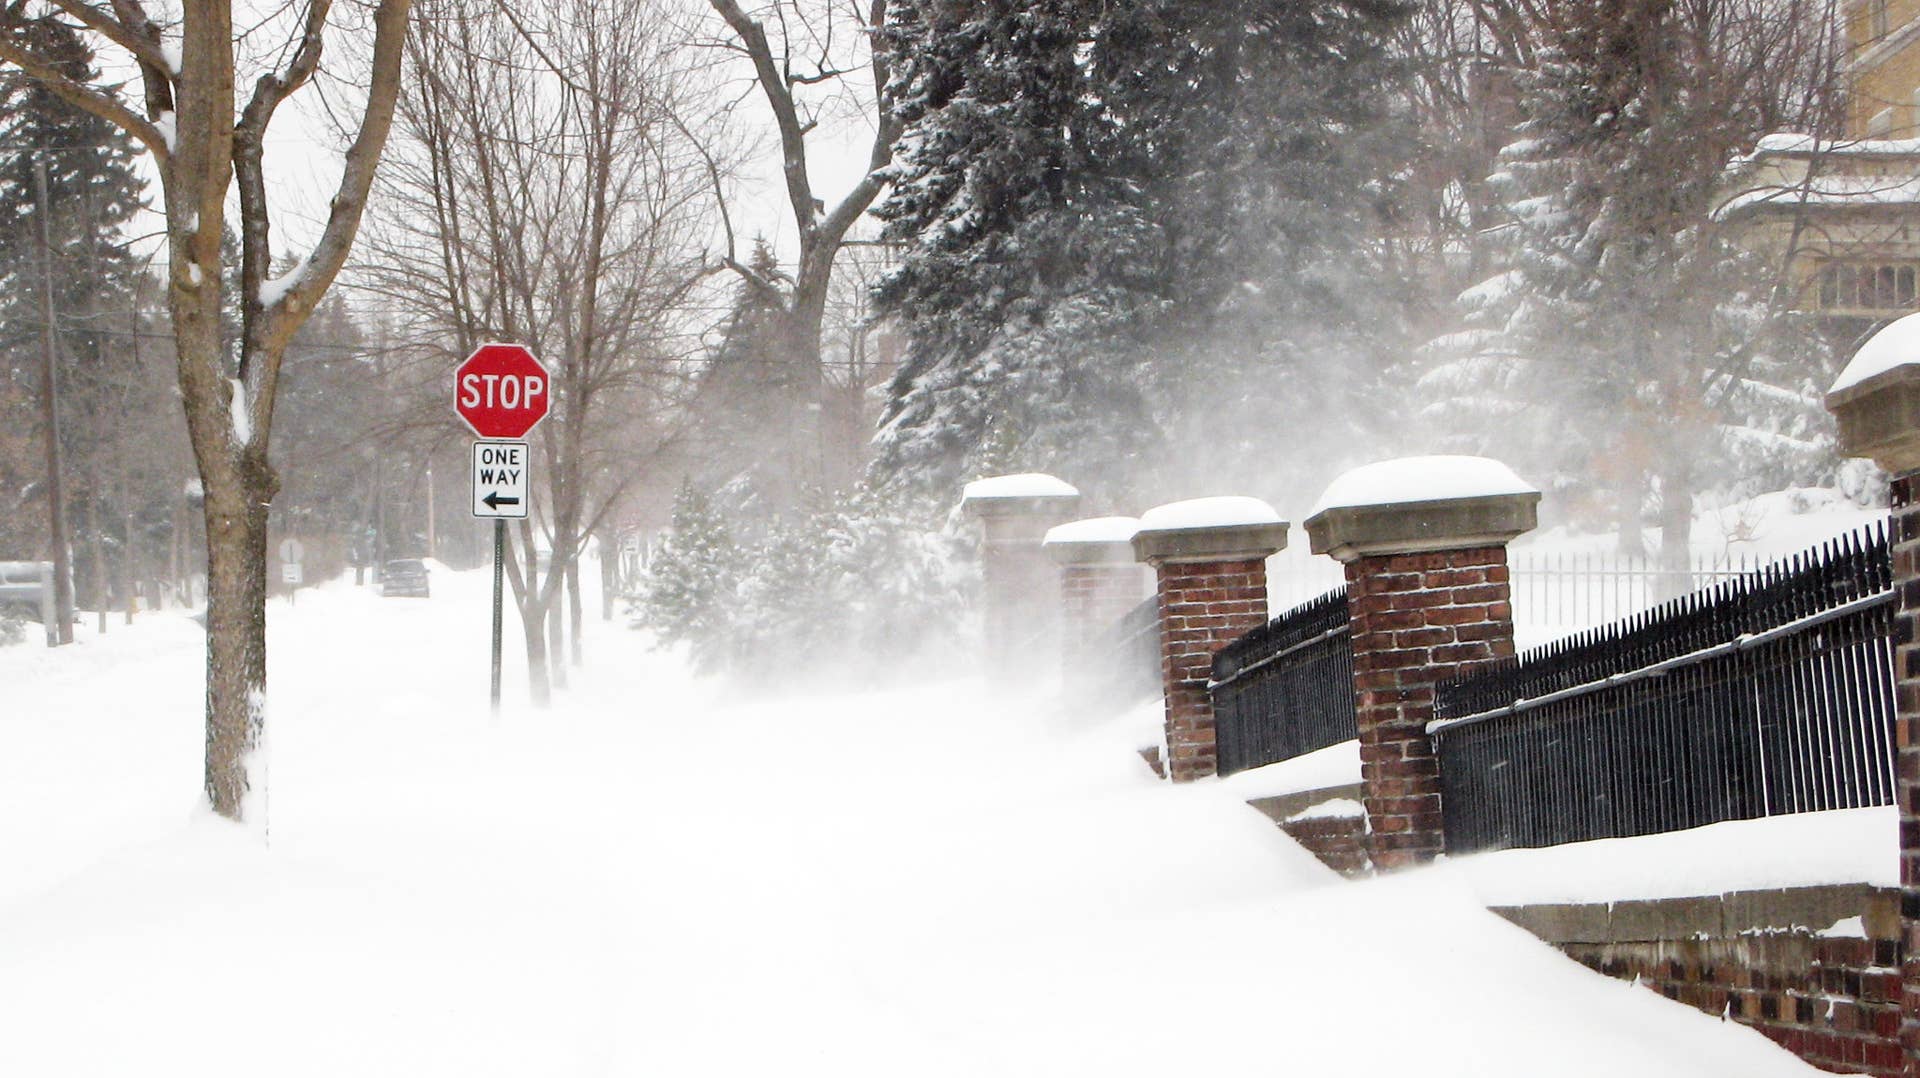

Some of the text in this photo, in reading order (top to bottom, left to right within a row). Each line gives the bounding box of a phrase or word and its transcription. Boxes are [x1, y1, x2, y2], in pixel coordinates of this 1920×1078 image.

[461, 373, 543, 410] STOP
[482, 448, 520, 465] ONE
[480, 469, 521, 485] WAY
